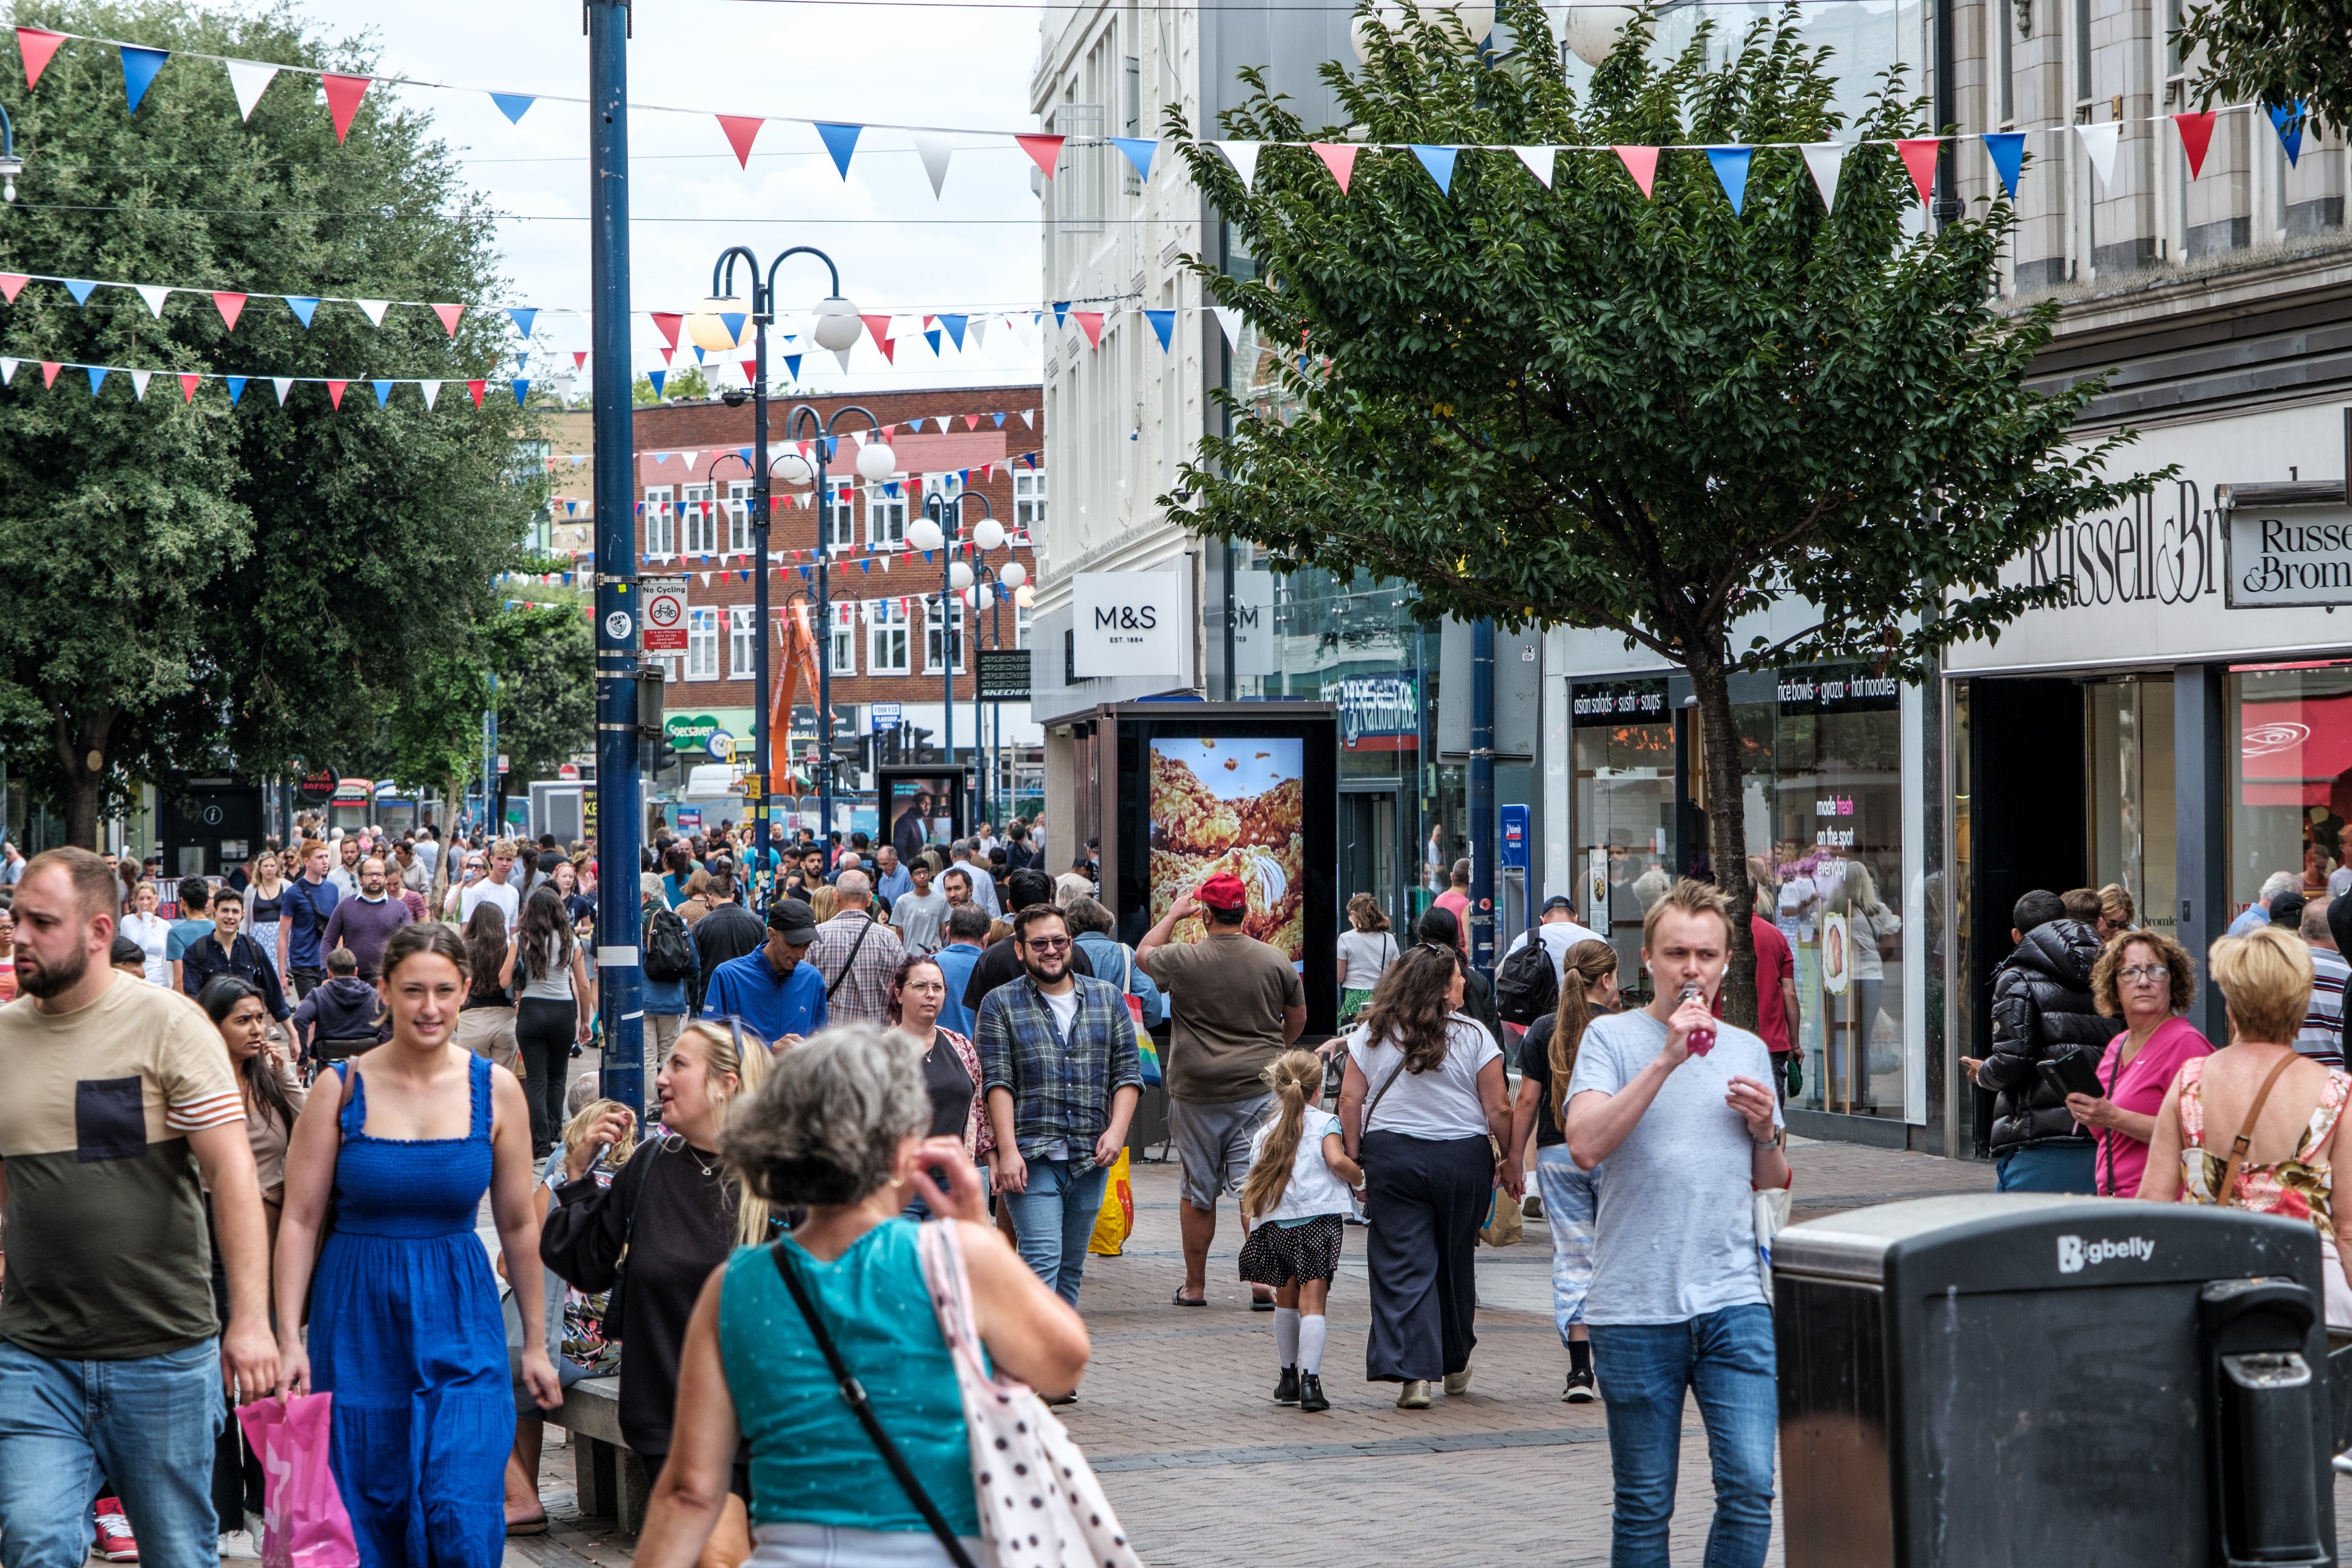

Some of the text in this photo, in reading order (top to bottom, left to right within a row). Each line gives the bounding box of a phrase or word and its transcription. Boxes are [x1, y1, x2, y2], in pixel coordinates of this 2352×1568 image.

[1095, 605, 1156, 630] M&S
[1777, 672, 1895, 705] rice bowls gyoza hot noodles
[1574, 690, 1661, 715] asian salads sushi soups
[669, 724, 715, 737] Specsavers
[1816, 794, 1853, 816] made fresh
[1817, 825, 1854, 851] on the spot
[1817, 855, 1847, 881] everyday
[2057, 1235, 2155, 1273] Bigbelly
